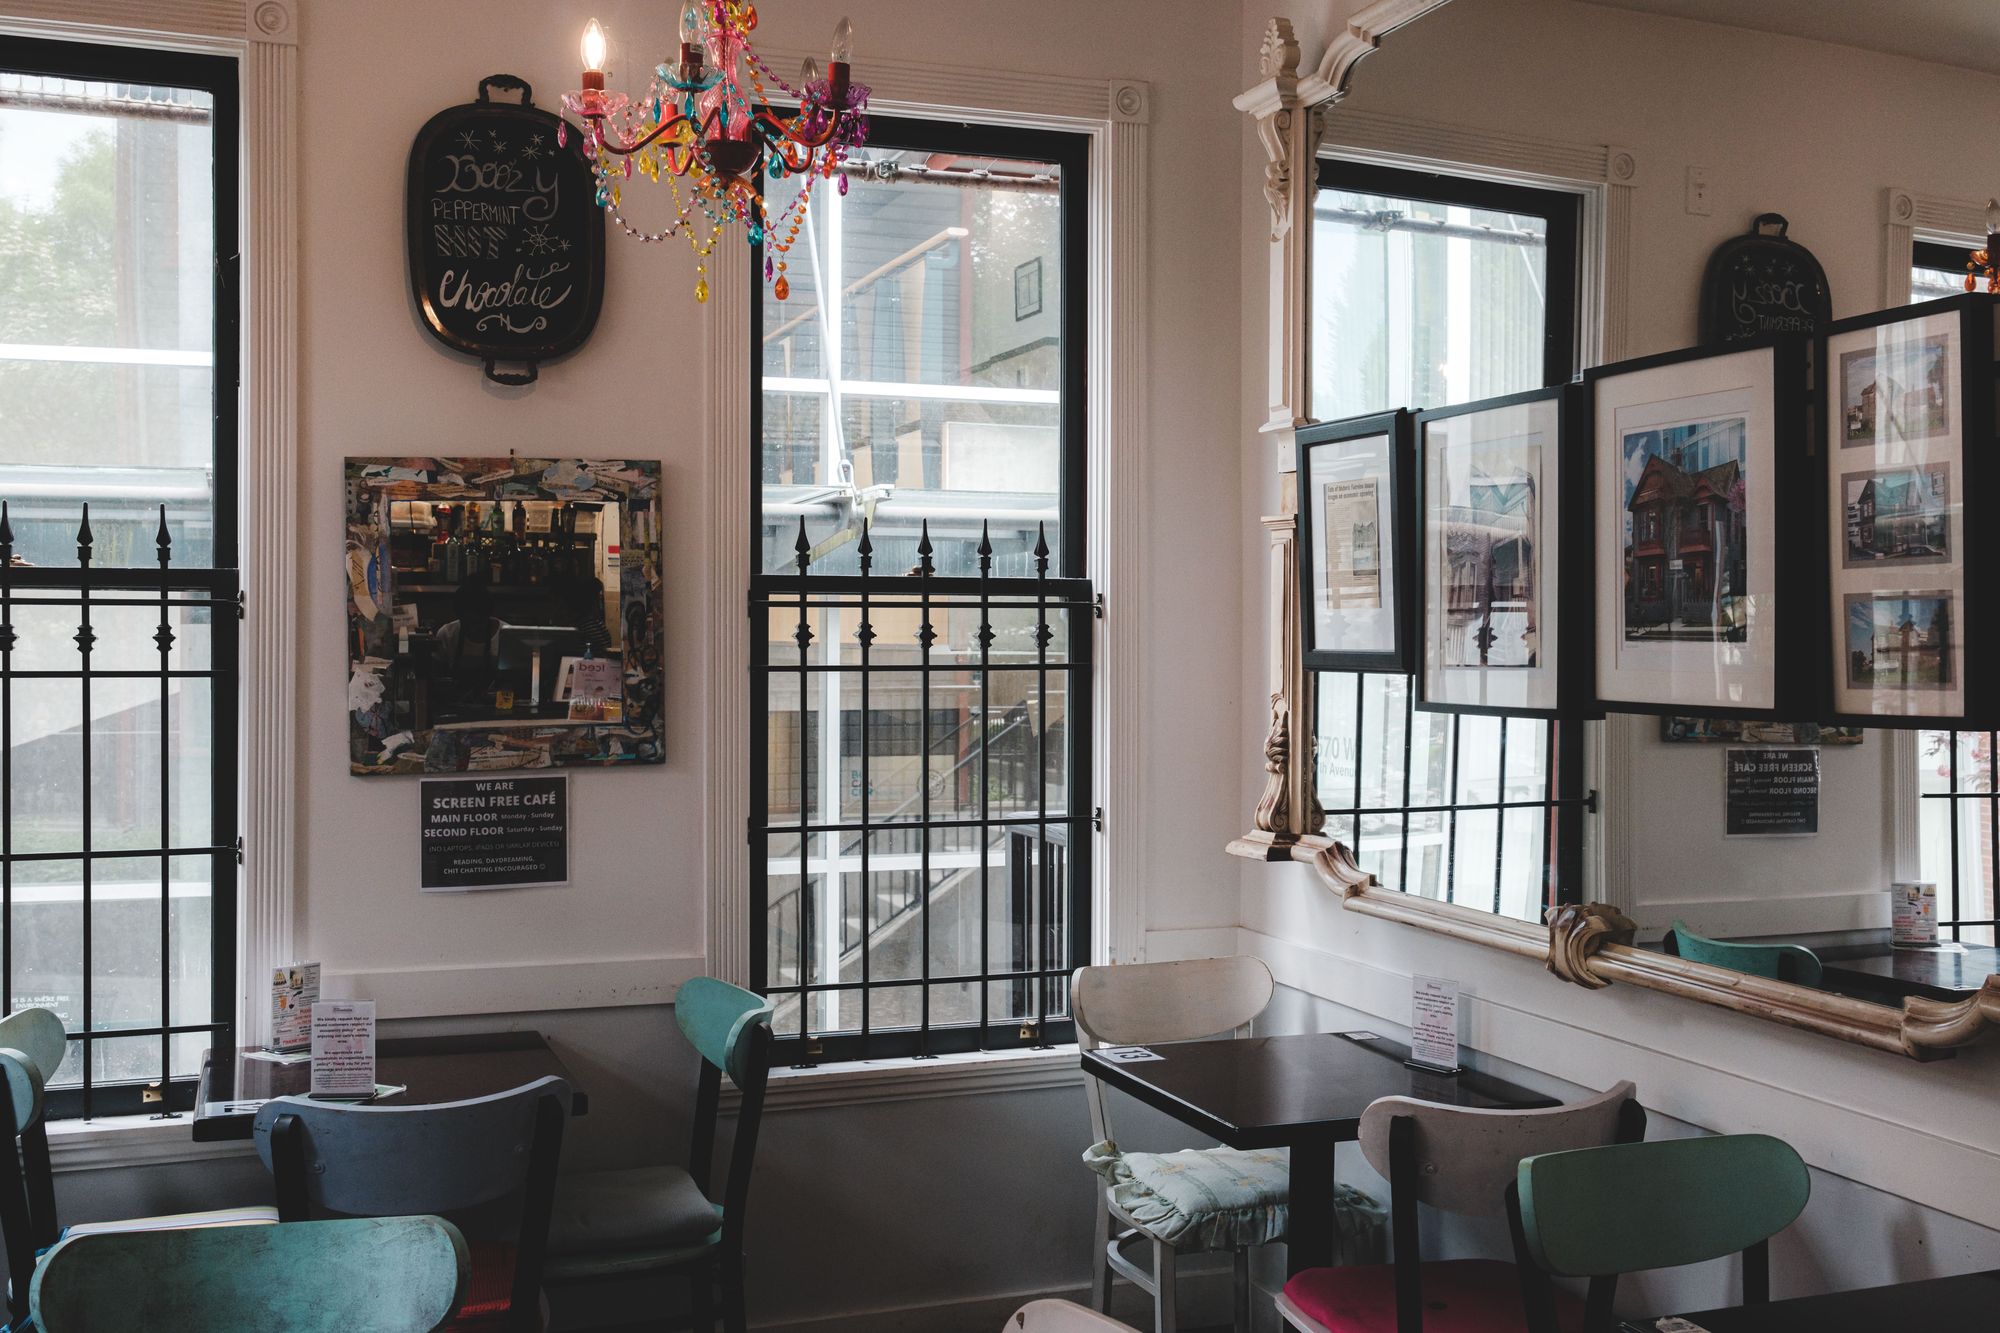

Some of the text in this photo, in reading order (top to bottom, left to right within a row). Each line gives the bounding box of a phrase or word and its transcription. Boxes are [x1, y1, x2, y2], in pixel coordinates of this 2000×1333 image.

[436, 155, 559, 221] Boozy
[432, 199, 521, 225] PEPPERMINT
[475, 782, 514, 791] WE ARE
[433, 791, 557, 809] SCREEN FREE CAFÉ
[431, 814, 461, 823] MAIN
[463, 813, 498, 822] FLOOR
[531, 811, 555, 819] Sunday
[424, 828, 467, 838] SECOND
[470, 826, 504, 836] FLOOR
[443, 864, 538, 875] CHIT CHATTING ENCOURAGED
